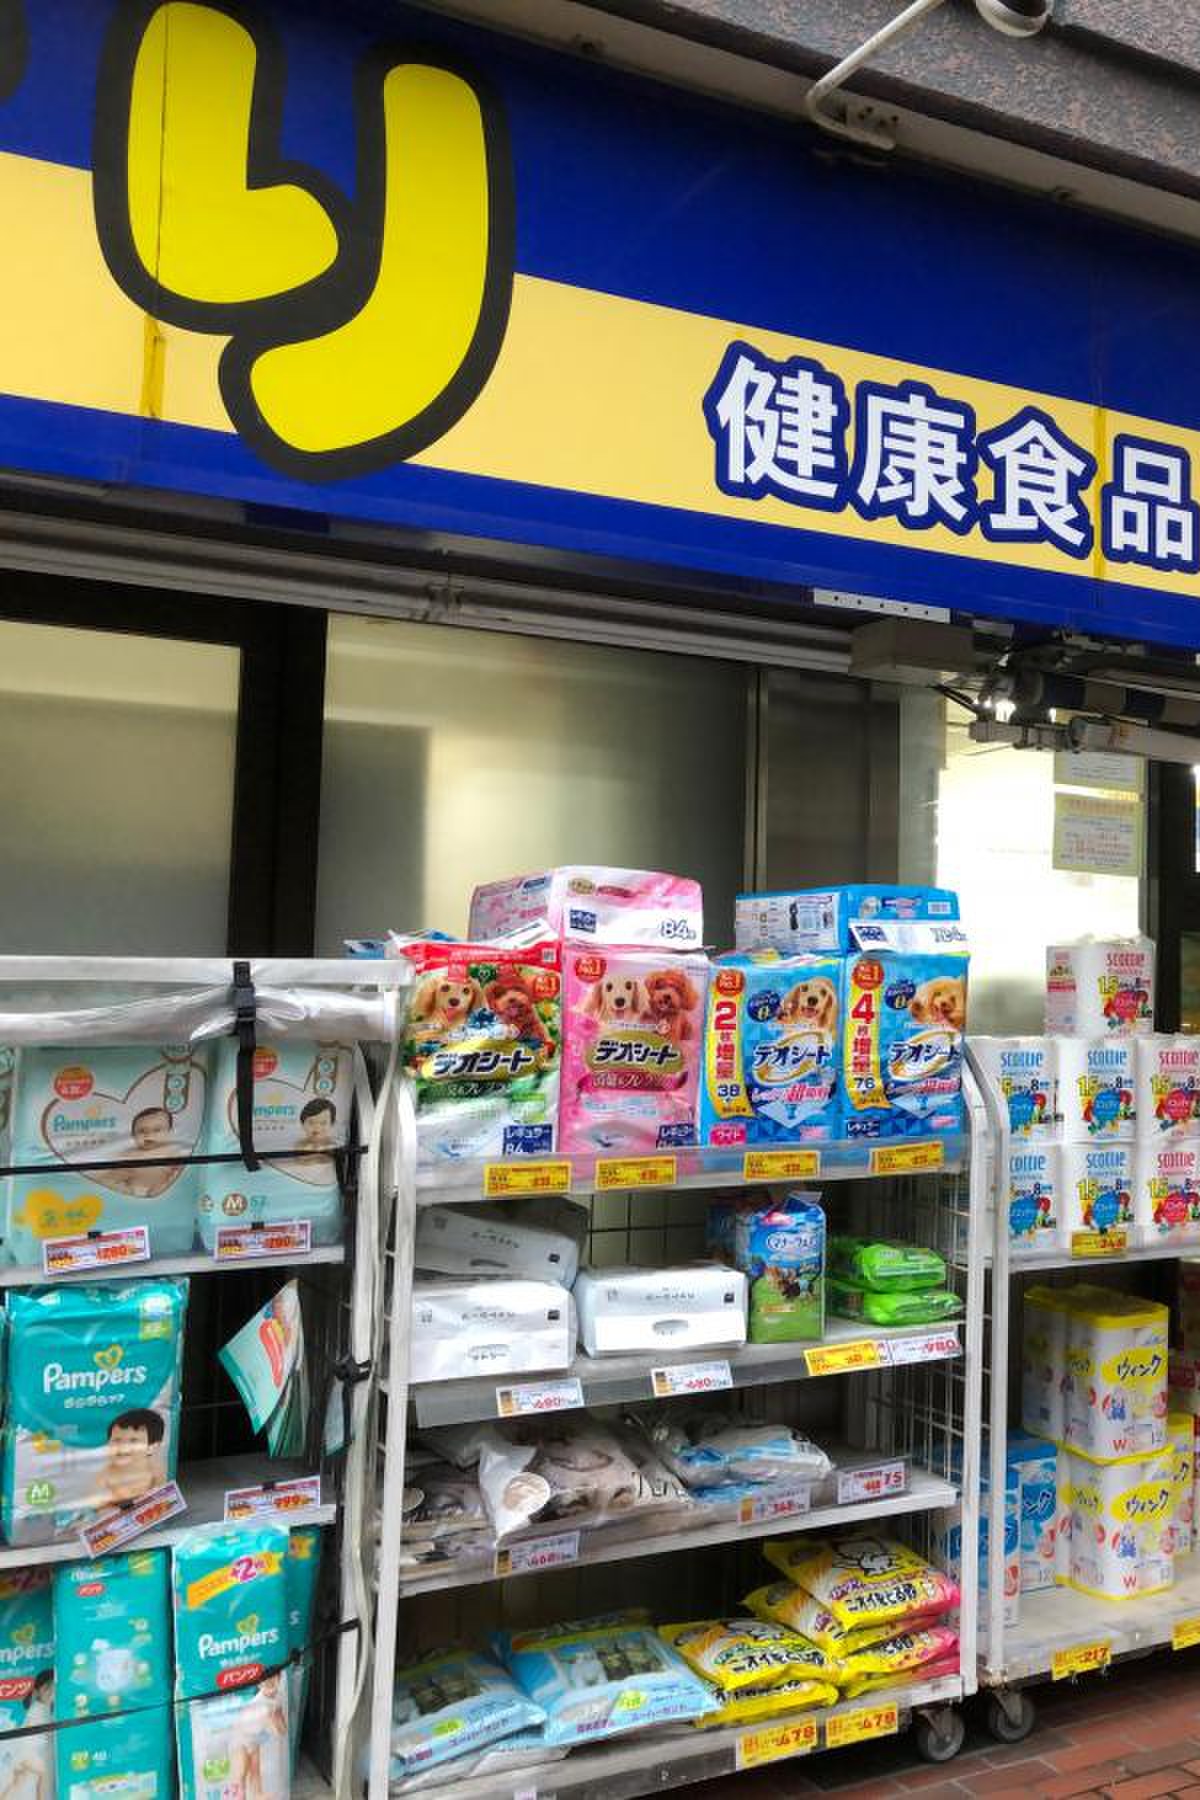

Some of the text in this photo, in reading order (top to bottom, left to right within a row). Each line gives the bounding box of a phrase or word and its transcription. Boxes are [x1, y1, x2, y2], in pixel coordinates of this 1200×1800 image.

[711, 349, 1197, 566] 健康食品
[434, 1050, 532, 1077] デオシート
[596, 1040, 678, 1065] デオシート
[754, 1044, 831, 1066] デオシート
[890, 1043, 960, 1063] デオシート
[252, 1103, 296, 1119] mpers
[44, 1363, 147, 1393] Pampers
[199, 1628, 279, 1659] Pampers
